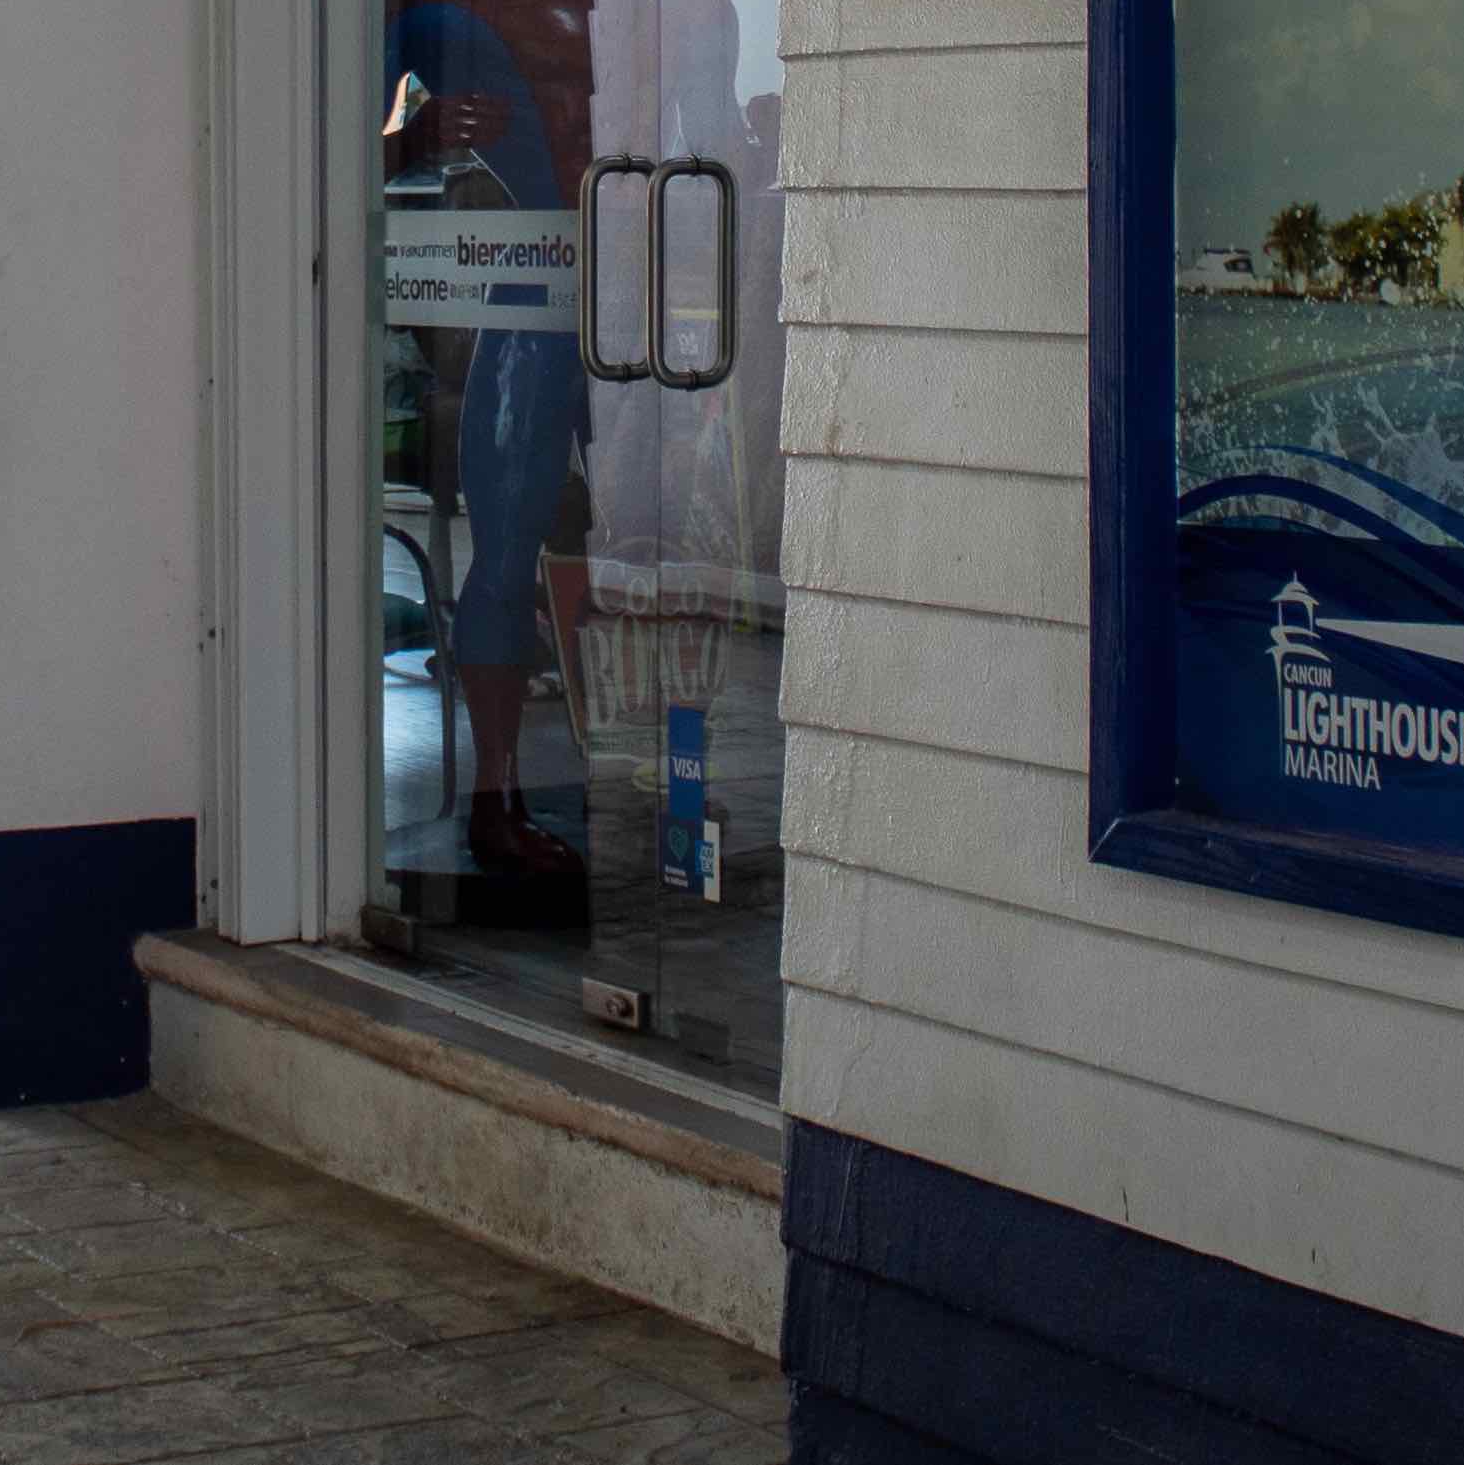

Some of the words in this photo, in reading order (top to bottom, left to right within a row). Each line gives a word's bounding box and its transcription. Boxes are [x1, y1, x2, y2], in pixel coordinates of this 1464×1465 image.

[455, 233, 576, 268] bienvenido
[384, 272, 448, 301] elcome
[1283, 663, 1332, 688] CANCUN
[672, 756, 702, 782] VISA
[1284, 744, 1382, 791] MARINA
